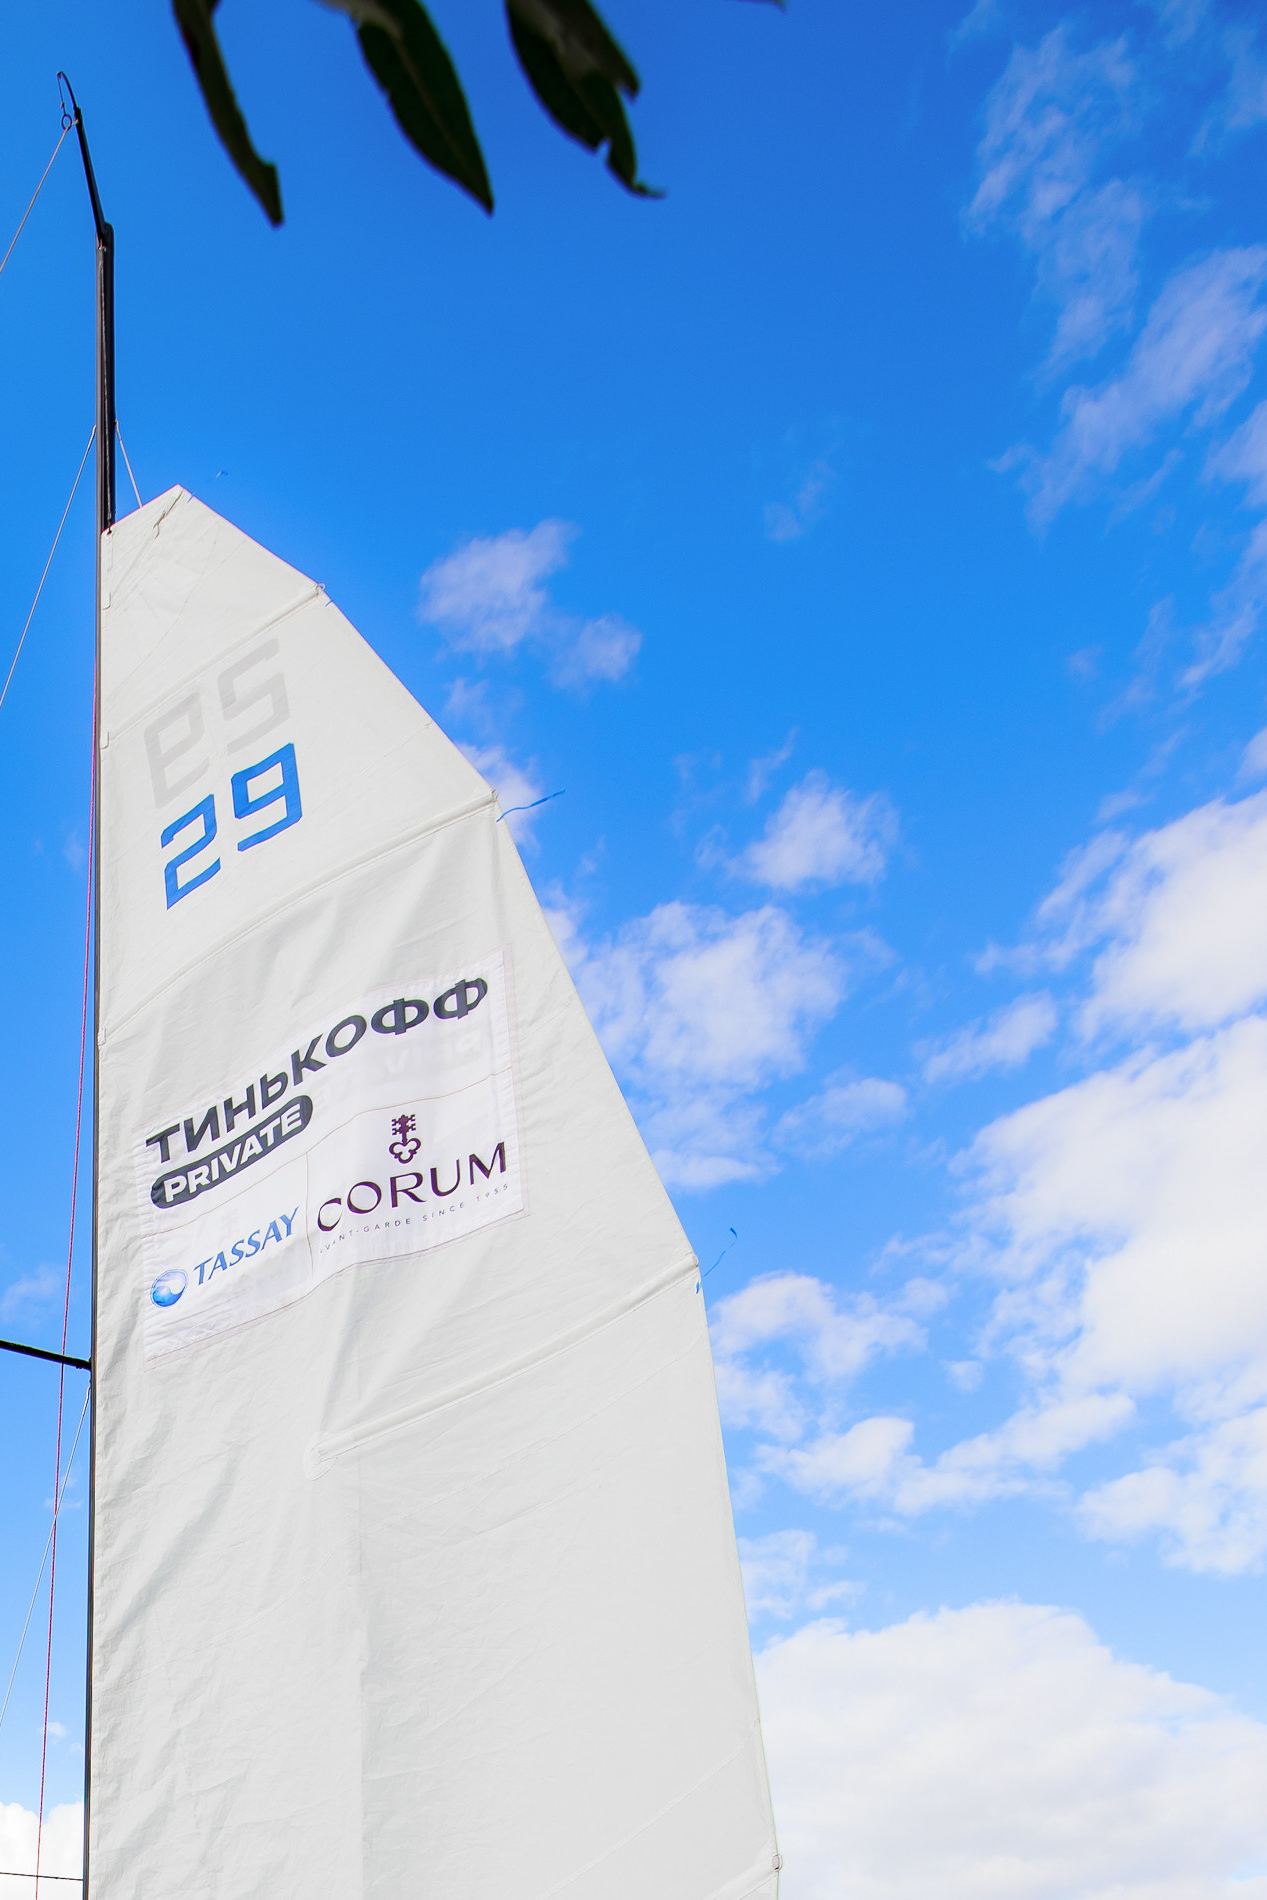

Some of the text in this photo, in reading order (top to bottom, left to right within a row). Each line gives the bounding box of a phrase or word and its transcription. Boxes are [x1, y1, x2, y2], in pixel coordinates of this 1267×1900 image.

[161, 742, 302, 911] 29
[145, 977, 488, 1163] ТИНЬКОФФ
[163, 1105, 304, 1203] PRIVATE
[317, 1141, 507, 1232] CORUM
[193, 1206, 300, 1286] TASSAY
[422, 1202, 465, 1222] SINCE
[476, 1183, 509, 1202] 1955
